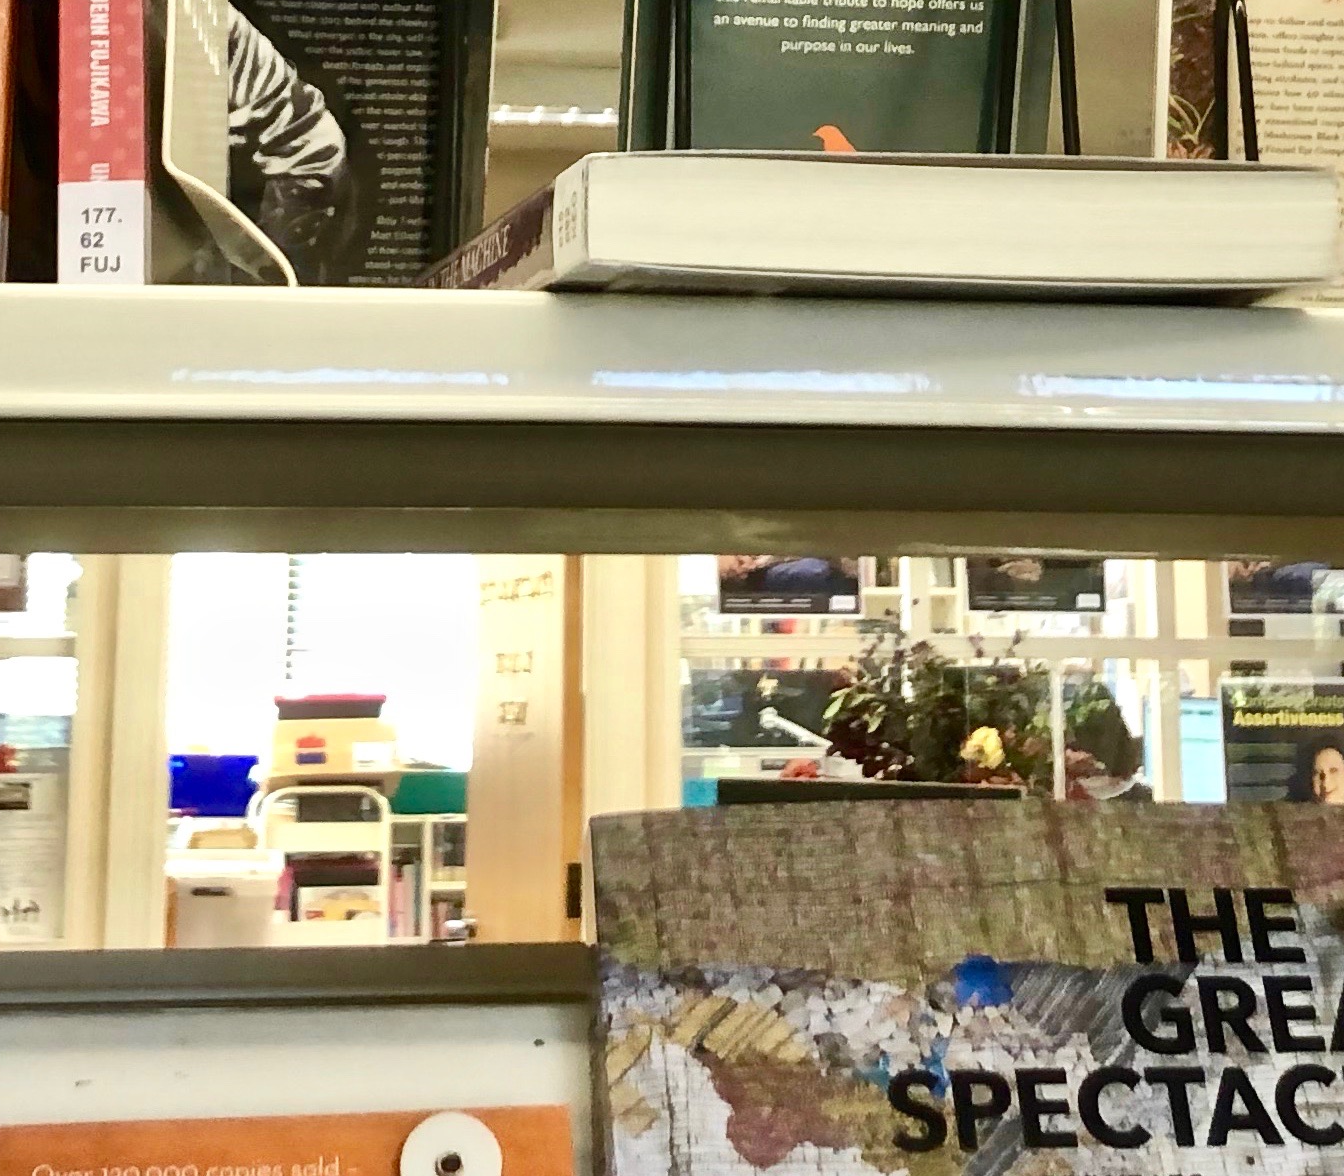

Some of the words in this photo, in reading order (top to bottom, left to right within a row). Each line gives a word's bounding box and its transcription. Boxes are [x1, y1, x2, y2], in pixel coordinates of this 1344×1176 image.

[89, 39, 110, 126] FUJIKAWA
[81, 209, 122, 224] 177.
[80, 233, 105, 249] 62
[80, 257, 121, 273] FUJ
[1104, 887, 1309, 965] THE
